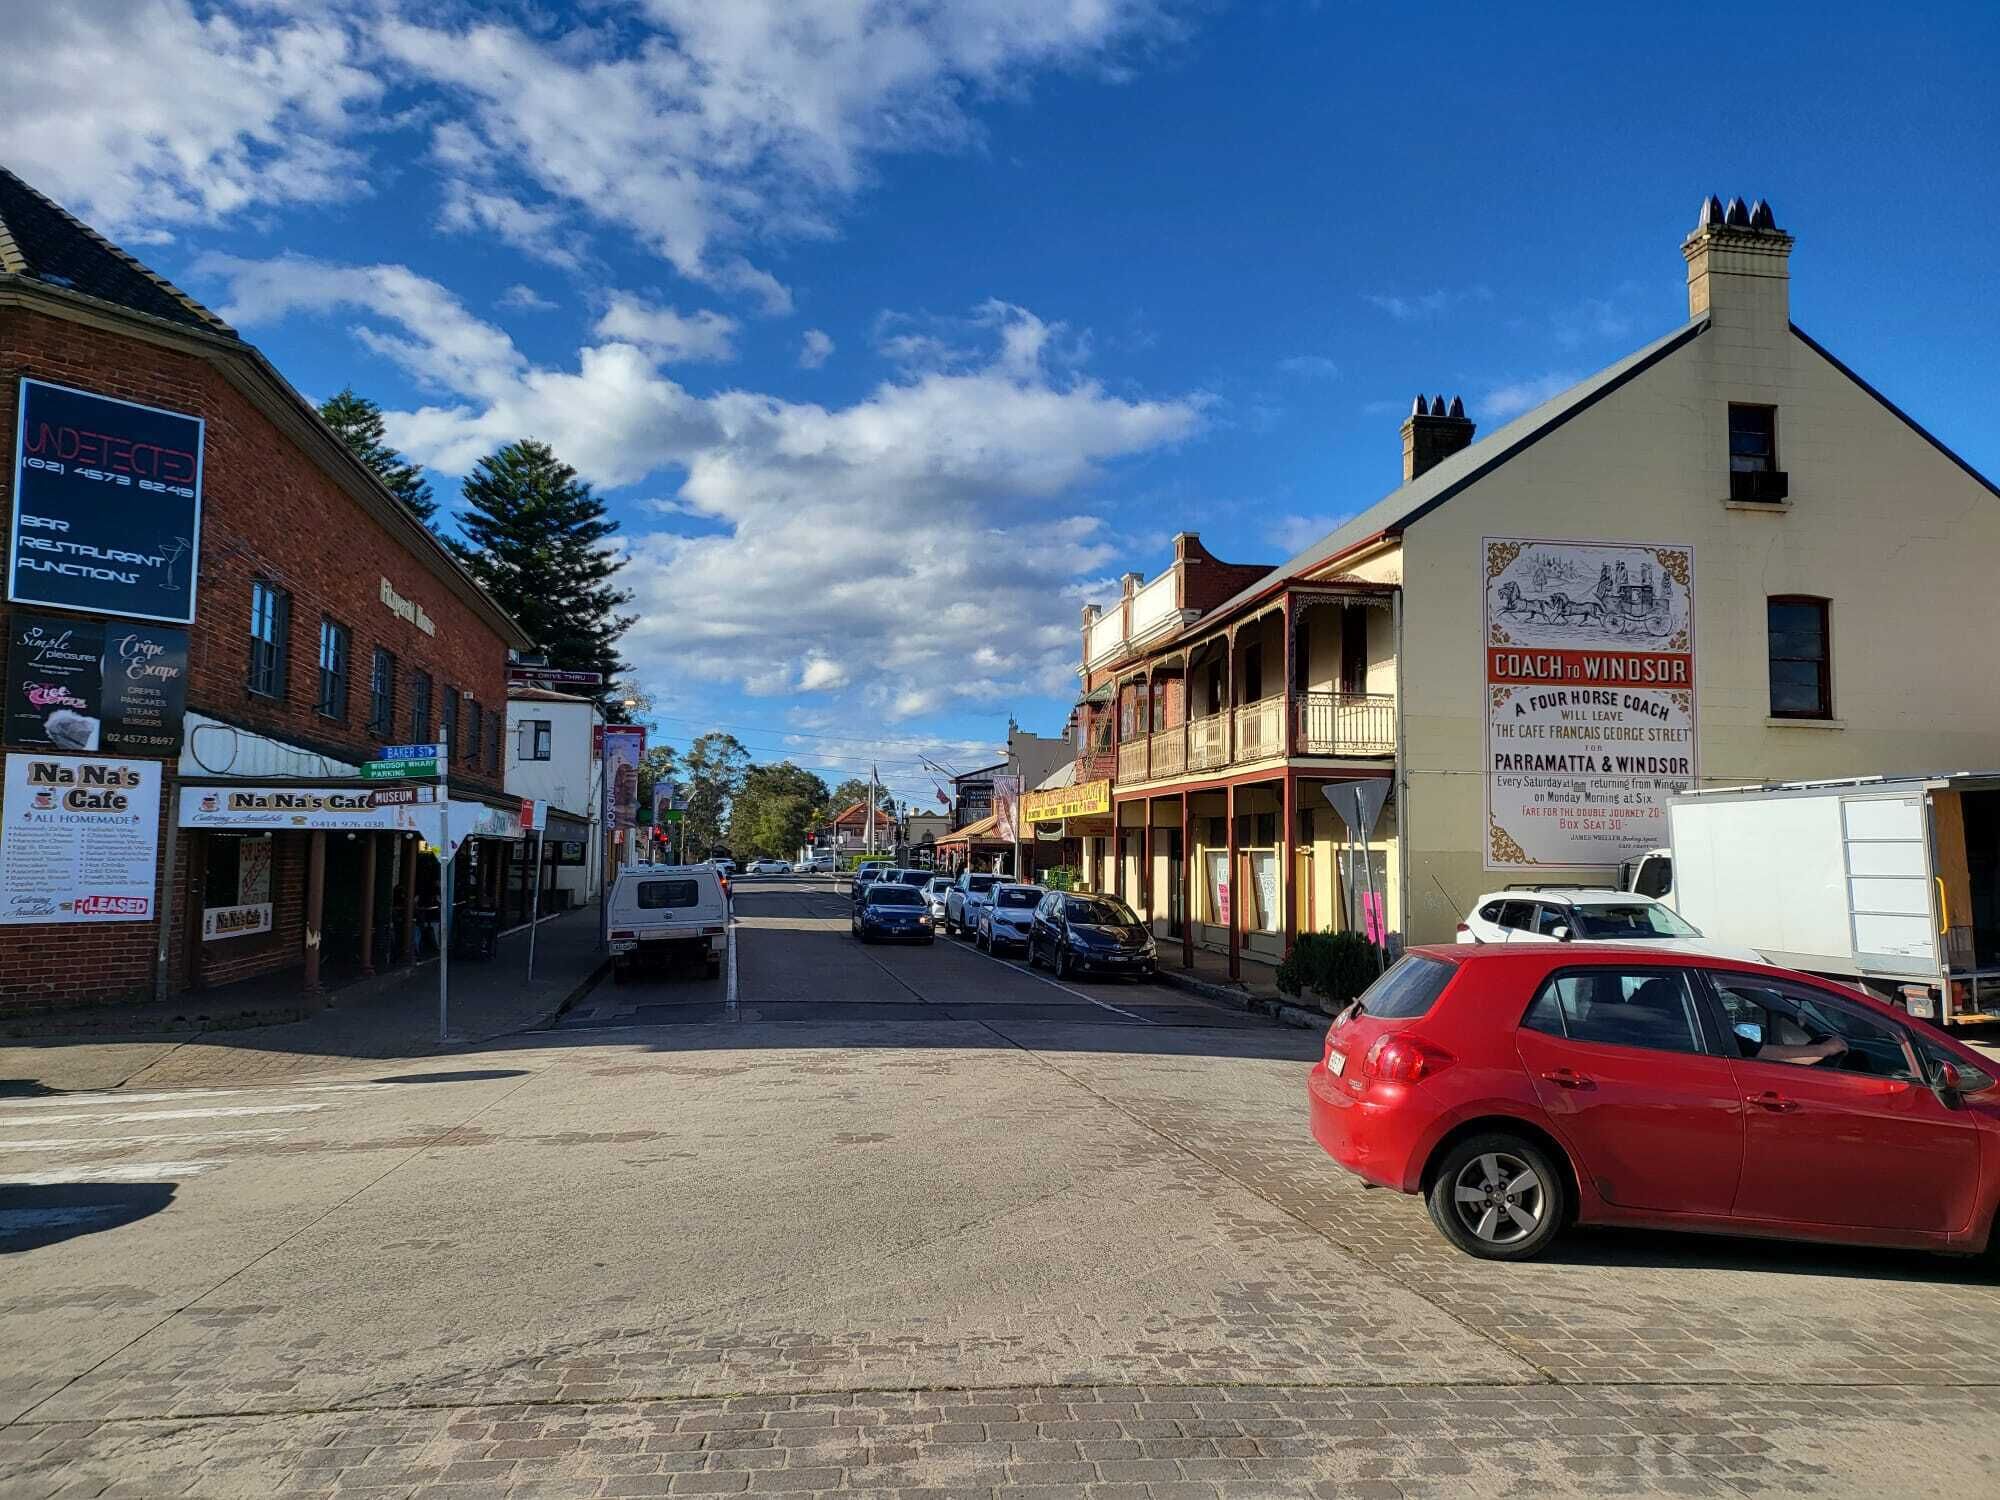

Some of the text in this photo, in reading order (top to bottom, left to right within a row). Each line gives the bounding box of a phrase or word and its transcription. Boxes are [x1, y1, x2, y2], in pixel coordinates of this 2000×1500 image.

[24, 418, 197, 483] UNDETECTED
[22, 456, 195, 498] (02) 4573 8249
[20, 514, 71, 533] BAR
[19, 535, 166, 568] RESTAURANT
[17, 557, 141, 584] FUNCTIONS
[16, 627, 73, 661] Simple
[46, 650, 97, 663] pleasures
[1495, 654, 1687, 682] COACH TO WINDSOR
[121, 697, 167, 707] PANCAKES
[1515, 690, 1670, 721] A FOUR HORSE COACH
[127, 708, 161, 716] STEAKS
[1561, 710, 1624, 722] WILL LEAVE
[122, 717, 162, 727] BURGERS
[107, 733, 121, 742] 02
[123, 734, 148, 744] 4573
[1496, 724, 1689, 742] THE CAFE FRANCAIS GEORGE STREET
[387, 747, 429, 758] BAKER ST
[1585, 744, 1603, 752] FOR
[371, 760, 434, 769] WINDSOR WHARF
[1495, 753, 1689, 774] PARRAMATTA & WINDSOR
[1497, 775, 1521, 788] Every
[1523, 775, 1562, 789] Saturday
[1590, 778, 1630, 790] returning
[1632, 778, 1651, 789] from
[1654, 779, 1689, 790] Windsor
[67, 788, 129, 810] Cafe
[376, 790, 412, 803] MUSEUM
[1534, 793, 1545, 802] on
[1547, 791, 1581, 803] Monday
[1585, 792, 1619, 805] Morning
[1623, 794, 1633, 803] at
[1522, 805, 1541, 816] FARE
[1543, 807, 1558, 817] FOR
[1560, 807, 1574, 817] THE
[1577, 807, 1605, 817] DOUBLE
[1609, 807, 1645, 818] JOURNEY
[34, 815, 132, 825] ALL HOMEMADE
[89, 896, 147, 913] LEASED
